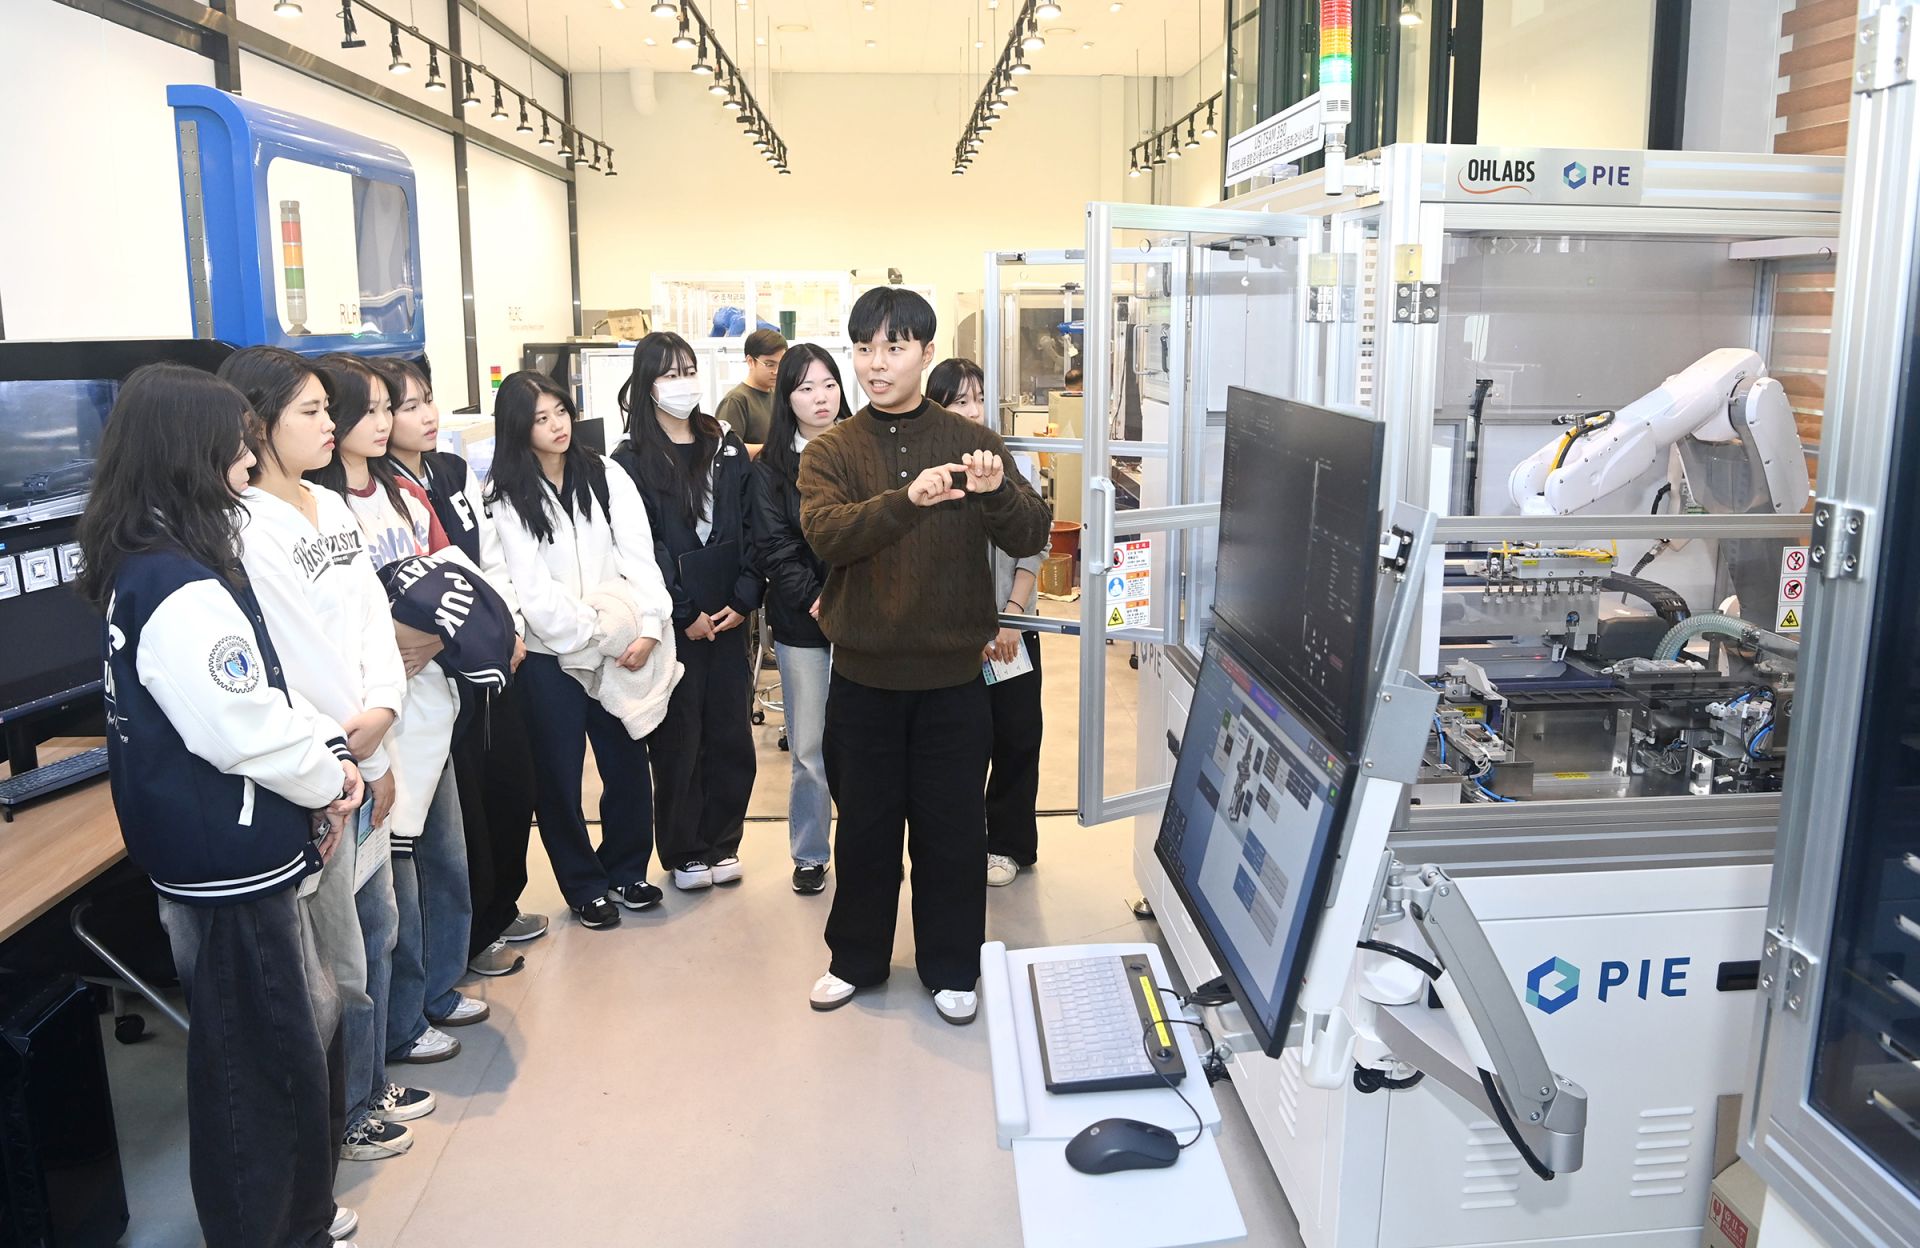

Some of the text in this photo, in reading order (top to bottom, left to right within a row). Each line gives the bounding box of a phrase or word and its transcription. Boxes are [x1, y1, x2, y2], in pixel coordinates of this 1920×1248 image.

[1468, 159, 1535, 182] OHLABS
[1593, 165, 1630, 187] PIE
[293, 525, 362, 579] Wisconsin
[435, 571, 474, 638] PUK
[1149, 642, 1161, 680] PIE
[1598, 957, 1691, 1003] PIE
